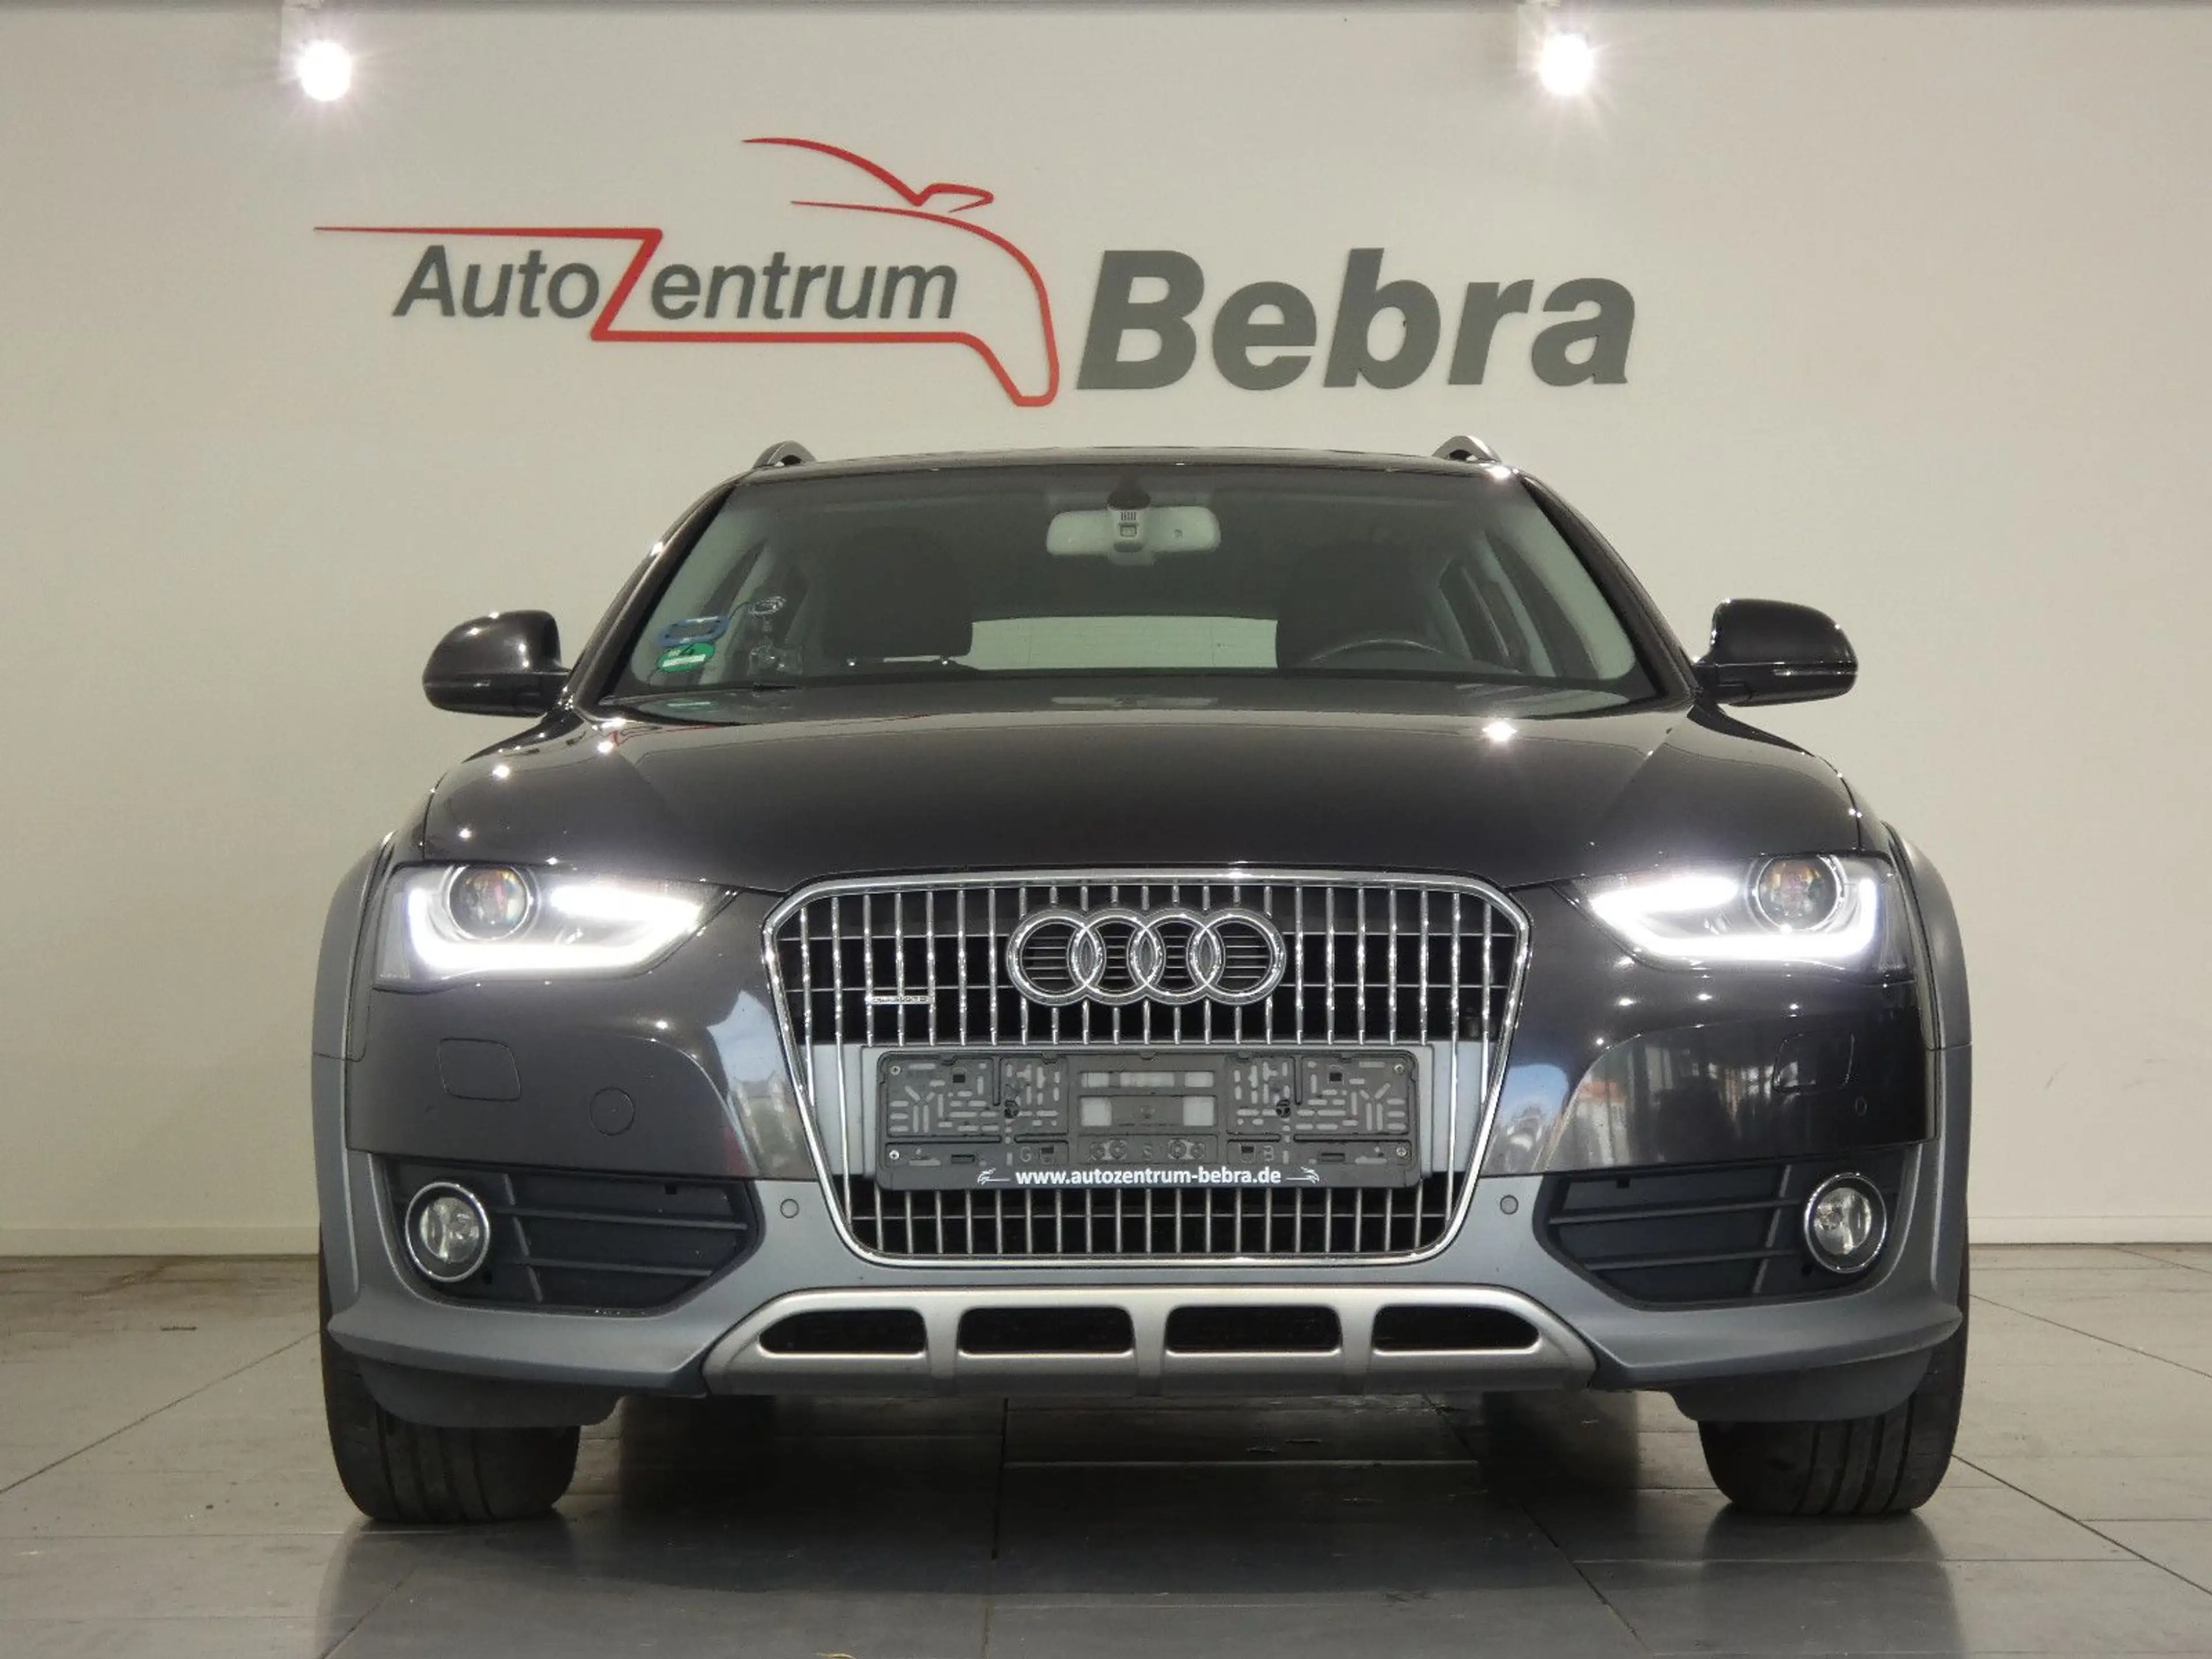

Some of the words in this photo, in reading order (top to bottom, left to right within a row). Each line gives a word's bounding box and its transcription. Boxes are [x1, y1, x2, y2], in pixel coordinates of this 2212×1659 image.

[392, 229, 957, 340] AutoZentrum
[1076, 248, 1635, 391] Bebra
[1015, 1165, 1282, 1185] www.autozentrum-bebra.de
